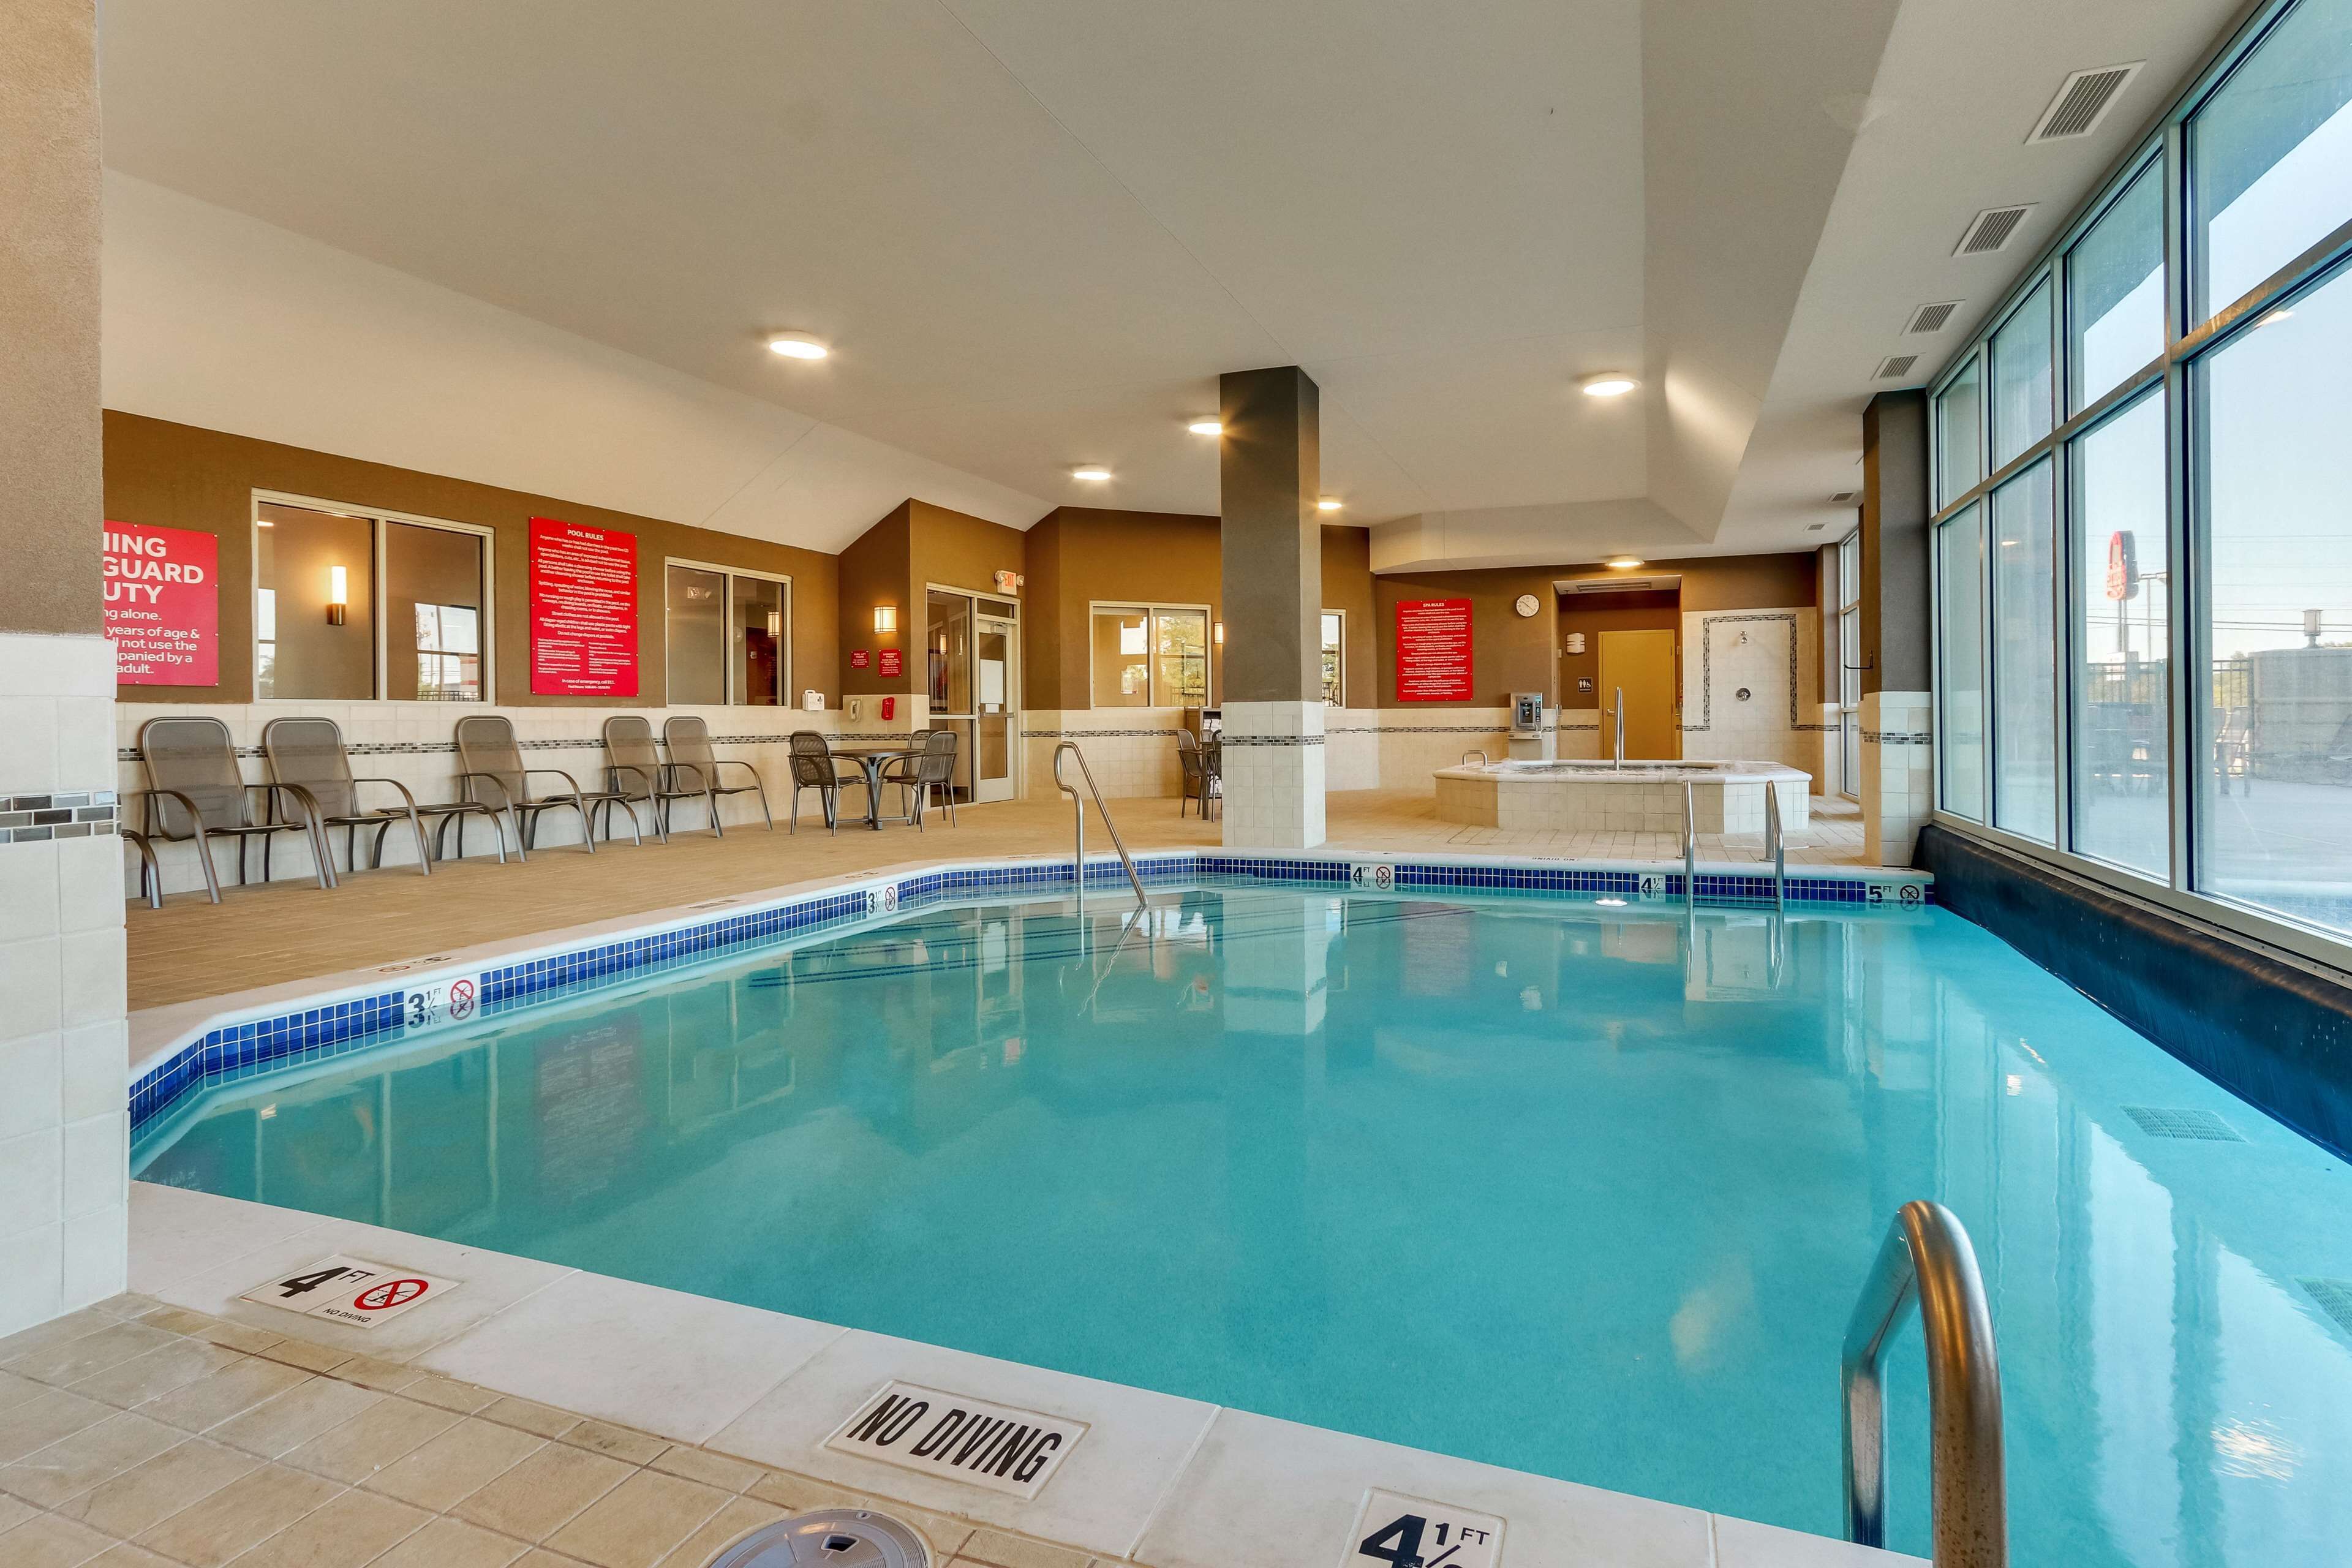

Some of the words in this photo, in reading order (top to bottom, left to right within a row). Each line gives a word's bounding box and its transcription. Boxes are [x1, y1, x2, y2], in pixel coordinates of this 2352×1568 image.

[567, 529, 584, 538] POOL
[585, 532, 604, 541] RULES
[104, 556, 203, 584] GUARD
[104, 581, 164, 604] UTY
[121, 608, 162, 620] alone.
[107, 626, 145, 636] years
[147, 627, 163, 636] of
[164, 630, 188, 639] age
[190, 629, 200, 639] &
[122, 639, 146, 649] not
[149, 641, 172, 650] use
[174, 641, 197, 651] the
[167, 652, 183, 664] by
[116, 664, 154, 674] adult.
[1353, 867, 1363, 878] 4
[1641, 878, 1653, 889] 4
[1869, 886, 1883, 899] 5
[409, 993, 425, 1012] 3
[277, 1266, 352, 1298] 4
[338, 1270, 377, 1284] FT
[338, 1310, 371, 1323] DIVING
[846, 1394, 930, 1447] NO
[908, 1409, 1063, 1483] DIVING
[1359, 1514, 1427, 1568] 4
[1460, 1527, 1490, 1545] FT
